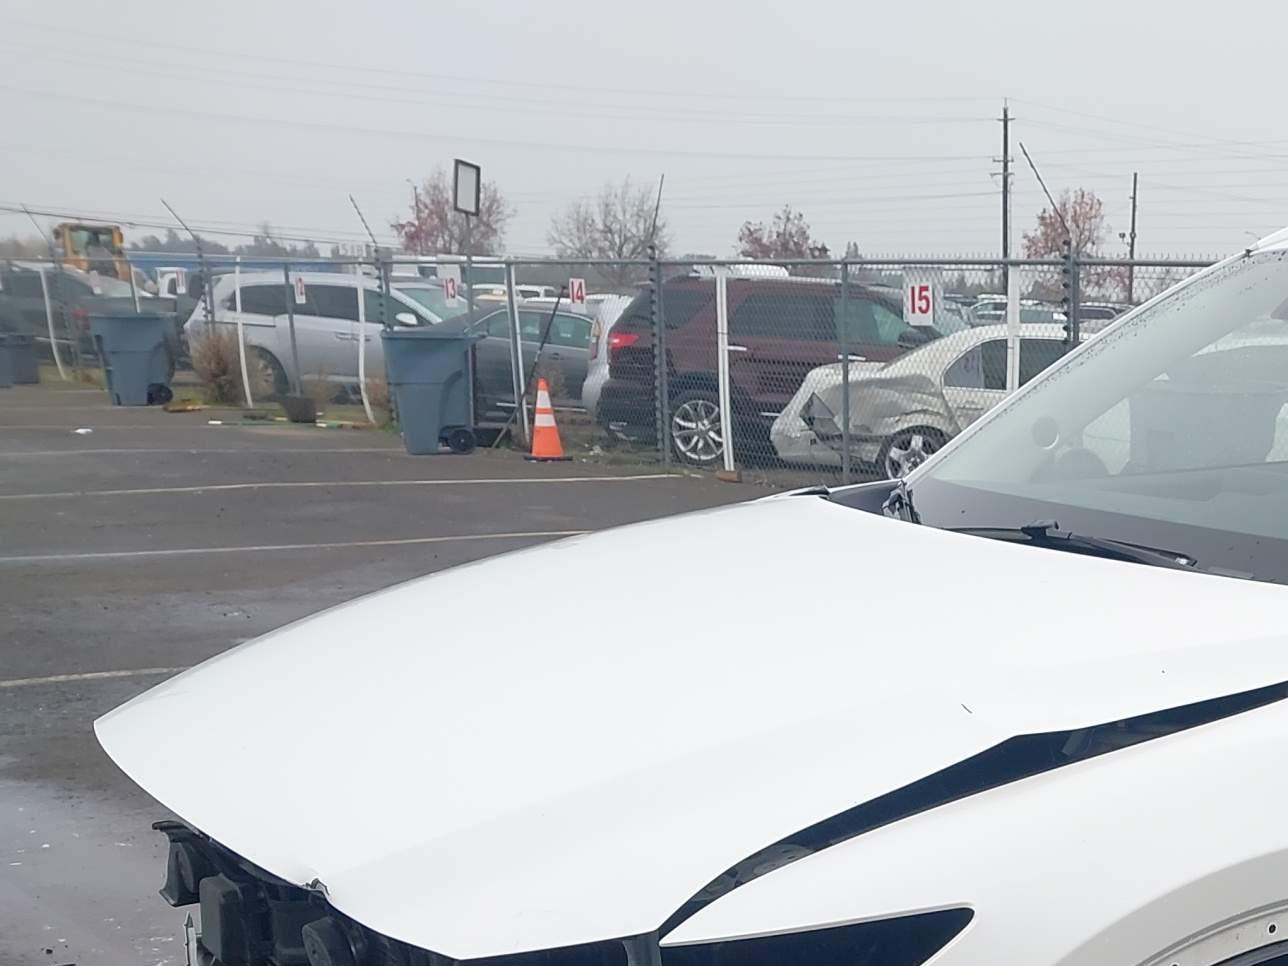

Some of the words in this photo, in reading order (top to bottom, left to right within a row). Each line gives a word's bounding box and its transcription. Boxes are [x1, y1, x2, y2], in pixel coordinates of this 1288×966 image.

[444, 279, 457, 299] 13
[570, 281, 584, 304] 14
[911, 285, 930, 315] 15
